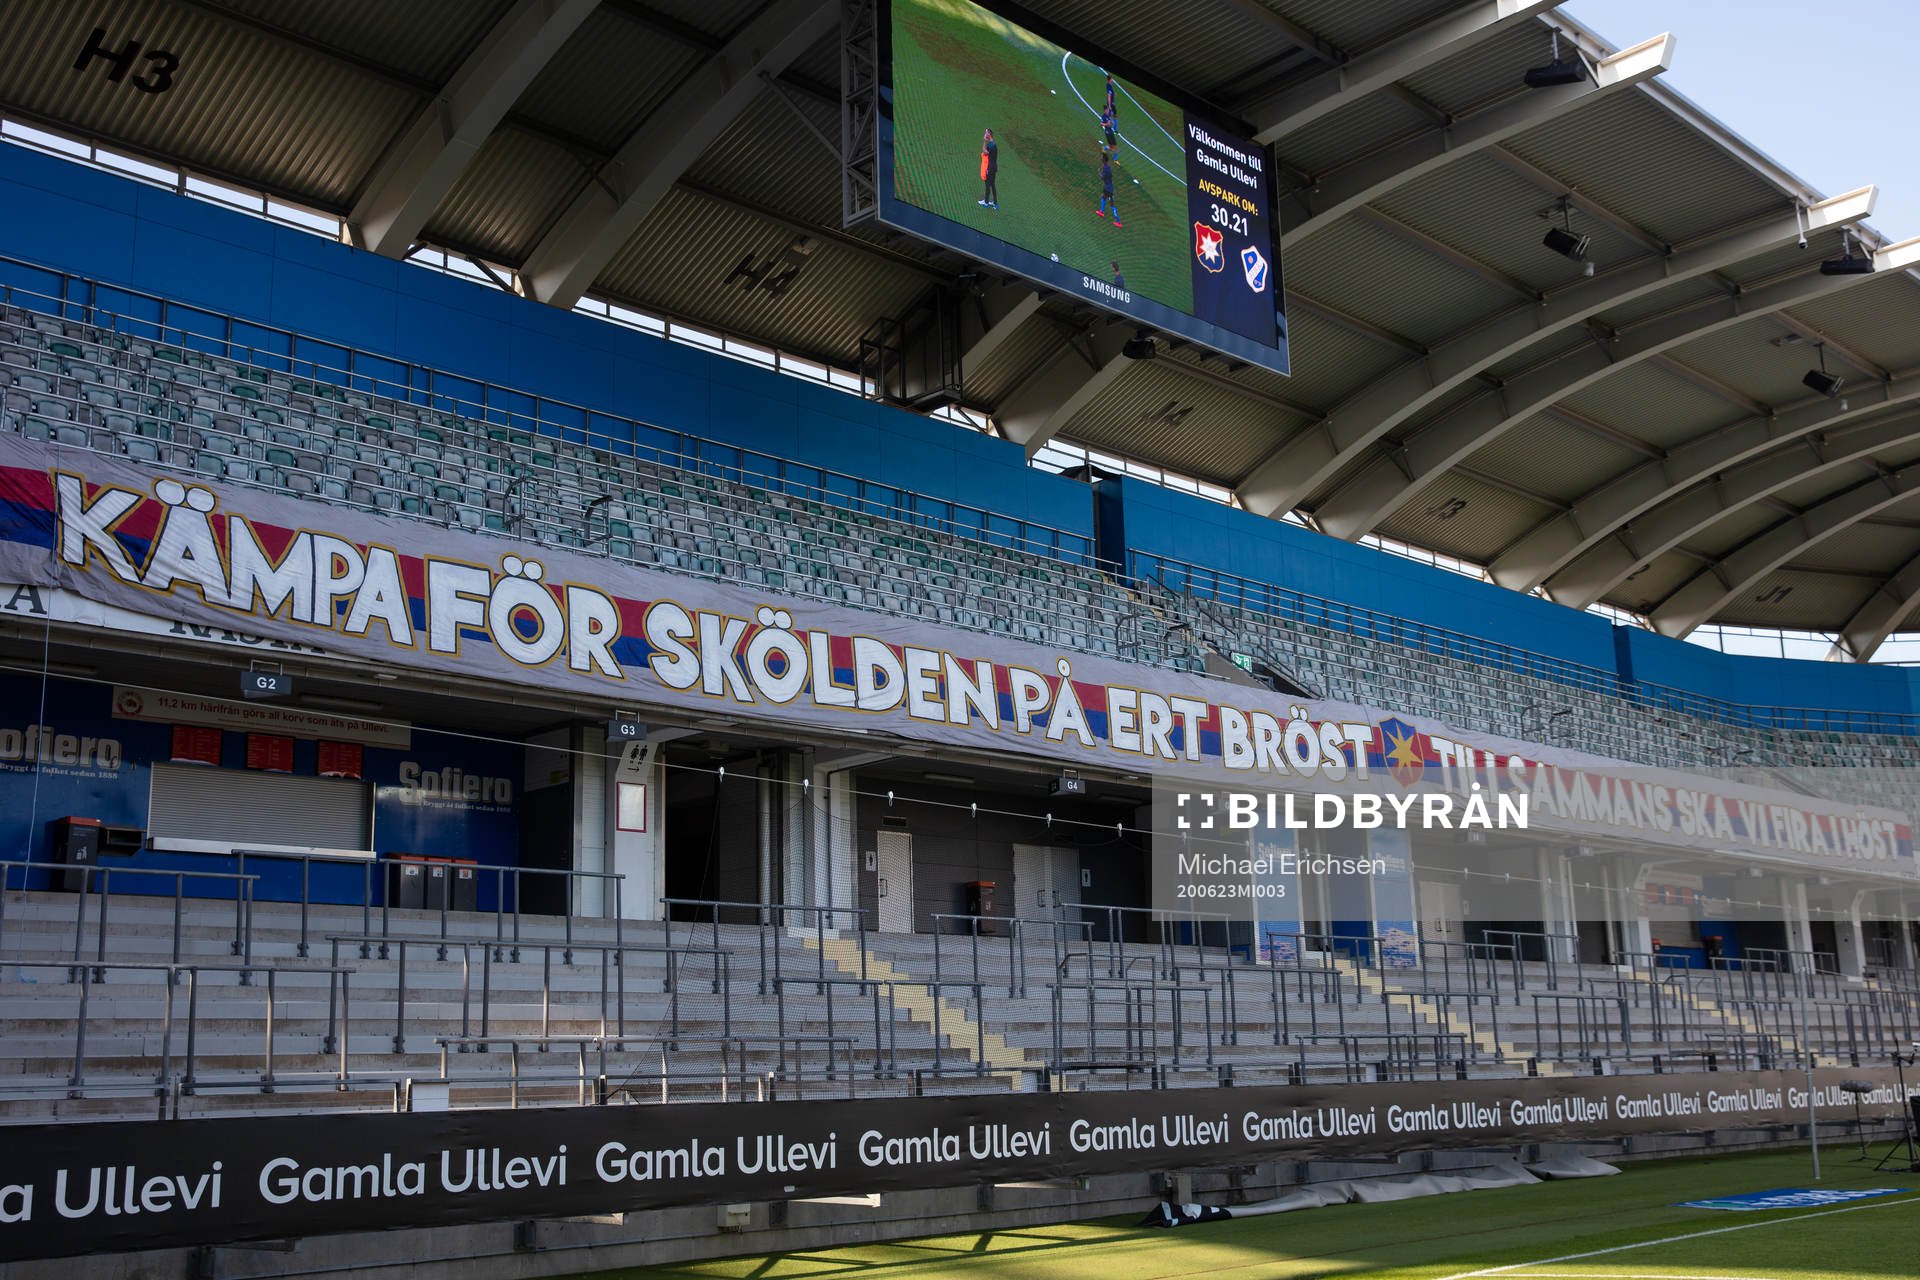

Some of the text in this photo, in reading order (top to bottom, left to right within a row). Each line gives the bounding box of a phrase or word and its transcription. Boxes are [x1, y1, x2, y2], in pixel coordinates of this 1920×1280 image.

[73, 27, 179, 93] H3
[1188, 123, 1262, 173] Välkommen till
[1196, 149, 1257, 189] Gamla Ullevi
[1198, 178, 1259, 216] AVSPARK OM:
[1210, 204, 1249, 236] 30.21
[1083, 276, 1131, 303] SAMSUNG
[52, 469, 417, 650] KÄMPA
[424, 552, 627, 681] FÖR
[643, 600, 1000, 731] SKÖLDEN
[1007, 656, 1097, 747] PÅ
[1105, 683, 1210, 762] ERT
[1218, 704, 1375, 782] BRÖST
[1429, 734, 1674, 833] TILLSAMMANS
[1676, 787, 1737, 842] SKA
[1737, 799, 1770, 847] VI
[1770, 804, 1830, 856] FIRA
[1829, 813, 1842, 857] I
[1841, 810, 1899, 861] HÖST
[256, 676, 276, 690] G2
[181, 700, 197, 710] km
[283, 712, 304, 722] korv
[307, 716, 328, 726] som
[621, 725, 635, 737] G3
[398, 760, 514, 806] Sofiero
[1067, 781, 1078, 791] G4
[1387, 1101, 1501, 1133] Gamla Ullevi
[1510, 1096, 1608, 1126] Gamla Ullevi
[1615, 1091, 1701, 1119] Gamla Ullevi
[1707, 1088, 1782, 1113] Gamla Ullevi
[1069, 1112, 1230, 1153] Gamla Ullevi
[1242, 1106, 1376, 1142] Gamla Ullevi
[595, 1132, 836, 1183] Gamla Ullevi
[858, 1122, 1051, 1168] Gamla Ullevi
[54, 1161, 223, 1219] Ullevi
[259, 1144, 567, 1204] Gamla Ullevi
